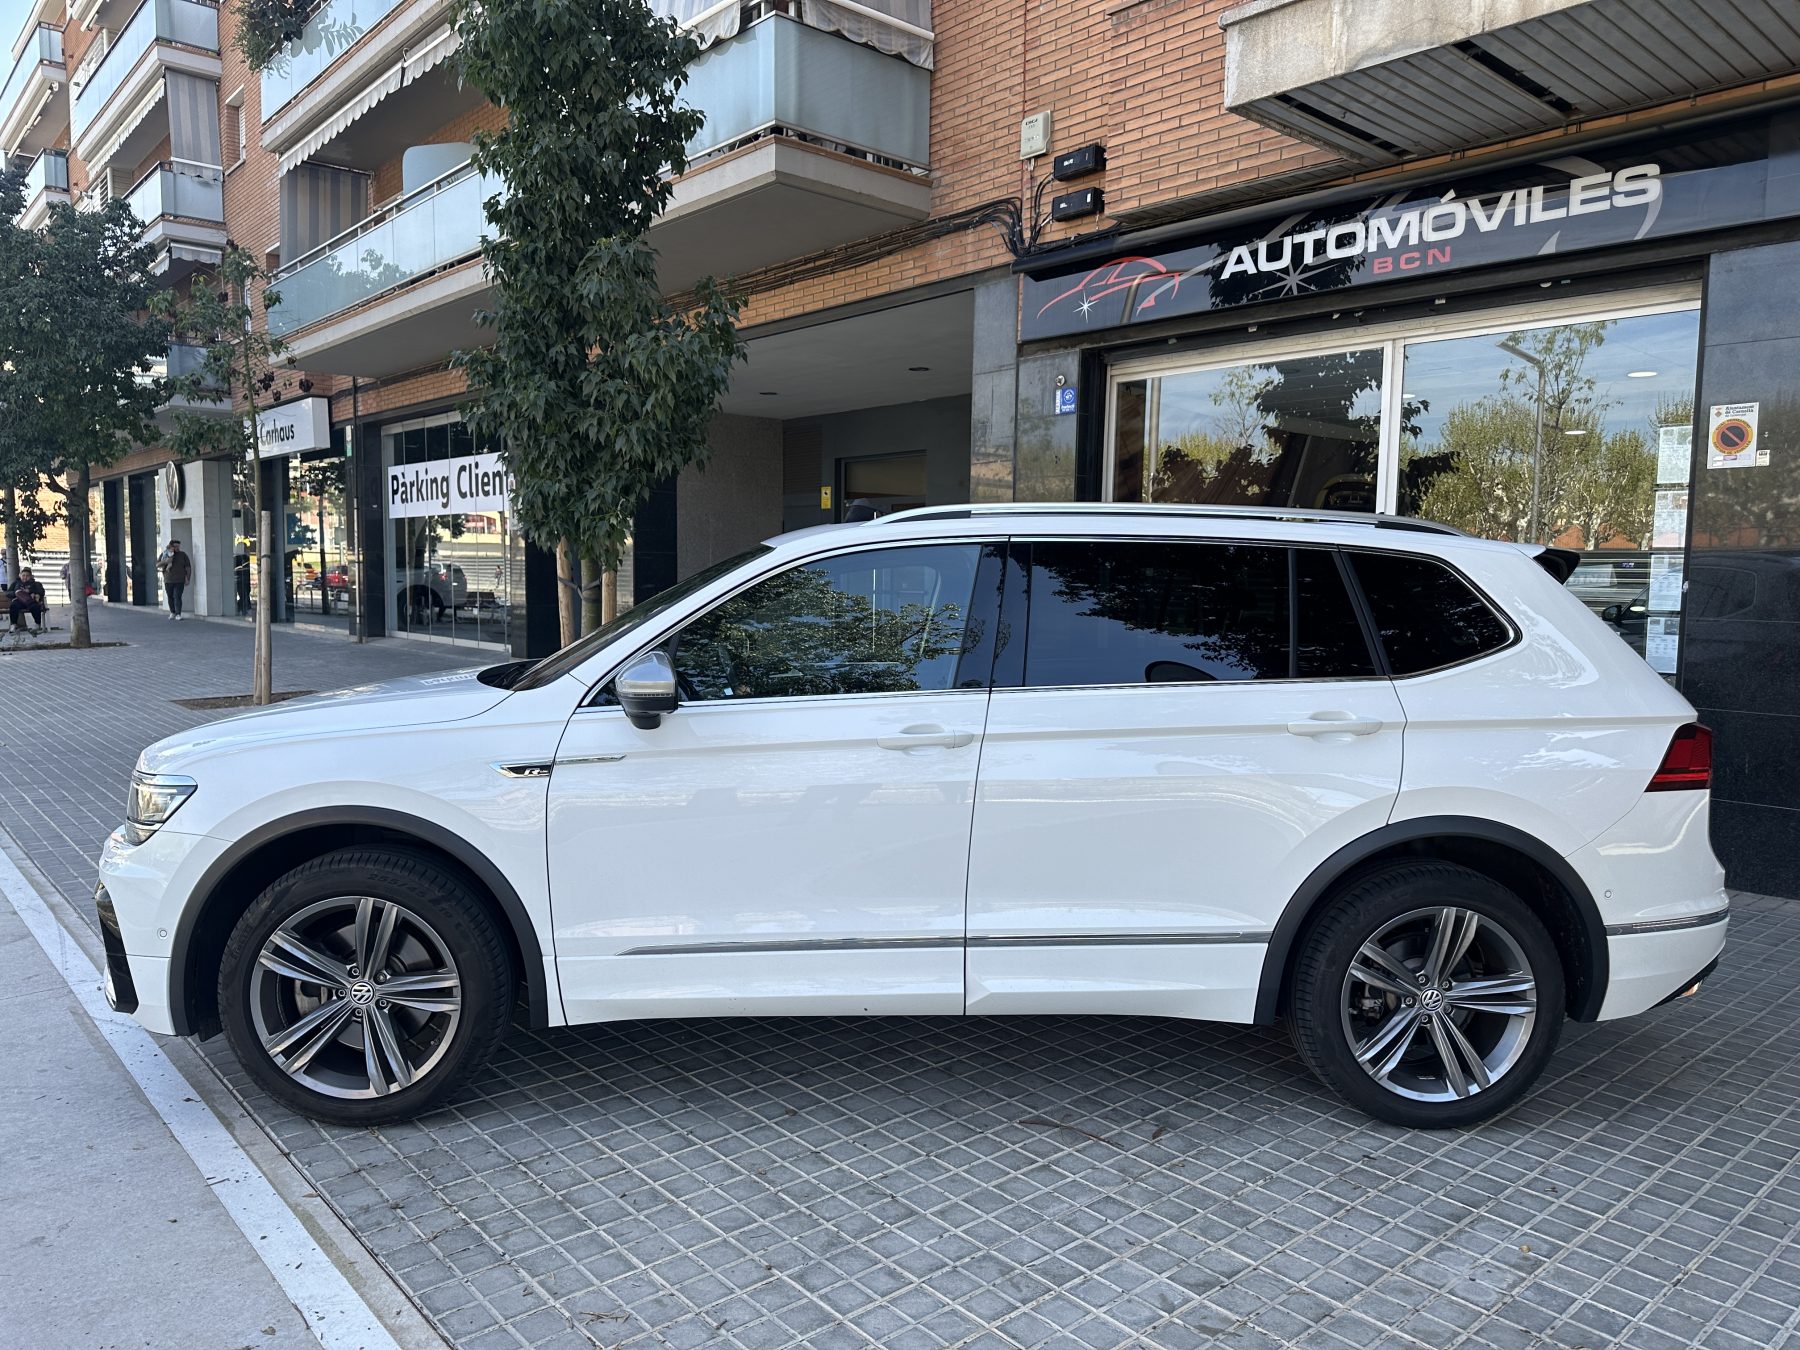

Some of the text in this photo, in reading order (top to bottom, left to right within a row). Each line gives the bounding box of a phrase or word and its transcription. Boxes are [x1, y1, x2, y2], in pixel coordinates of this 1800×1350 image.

[1220, 163, 1662, 280] AUTOMÓVILES
[1373, 246, 1451, 274] BCN
[260, 418, 295, 446] Carhaus
[391, 467, 450, 509] Pàrking
